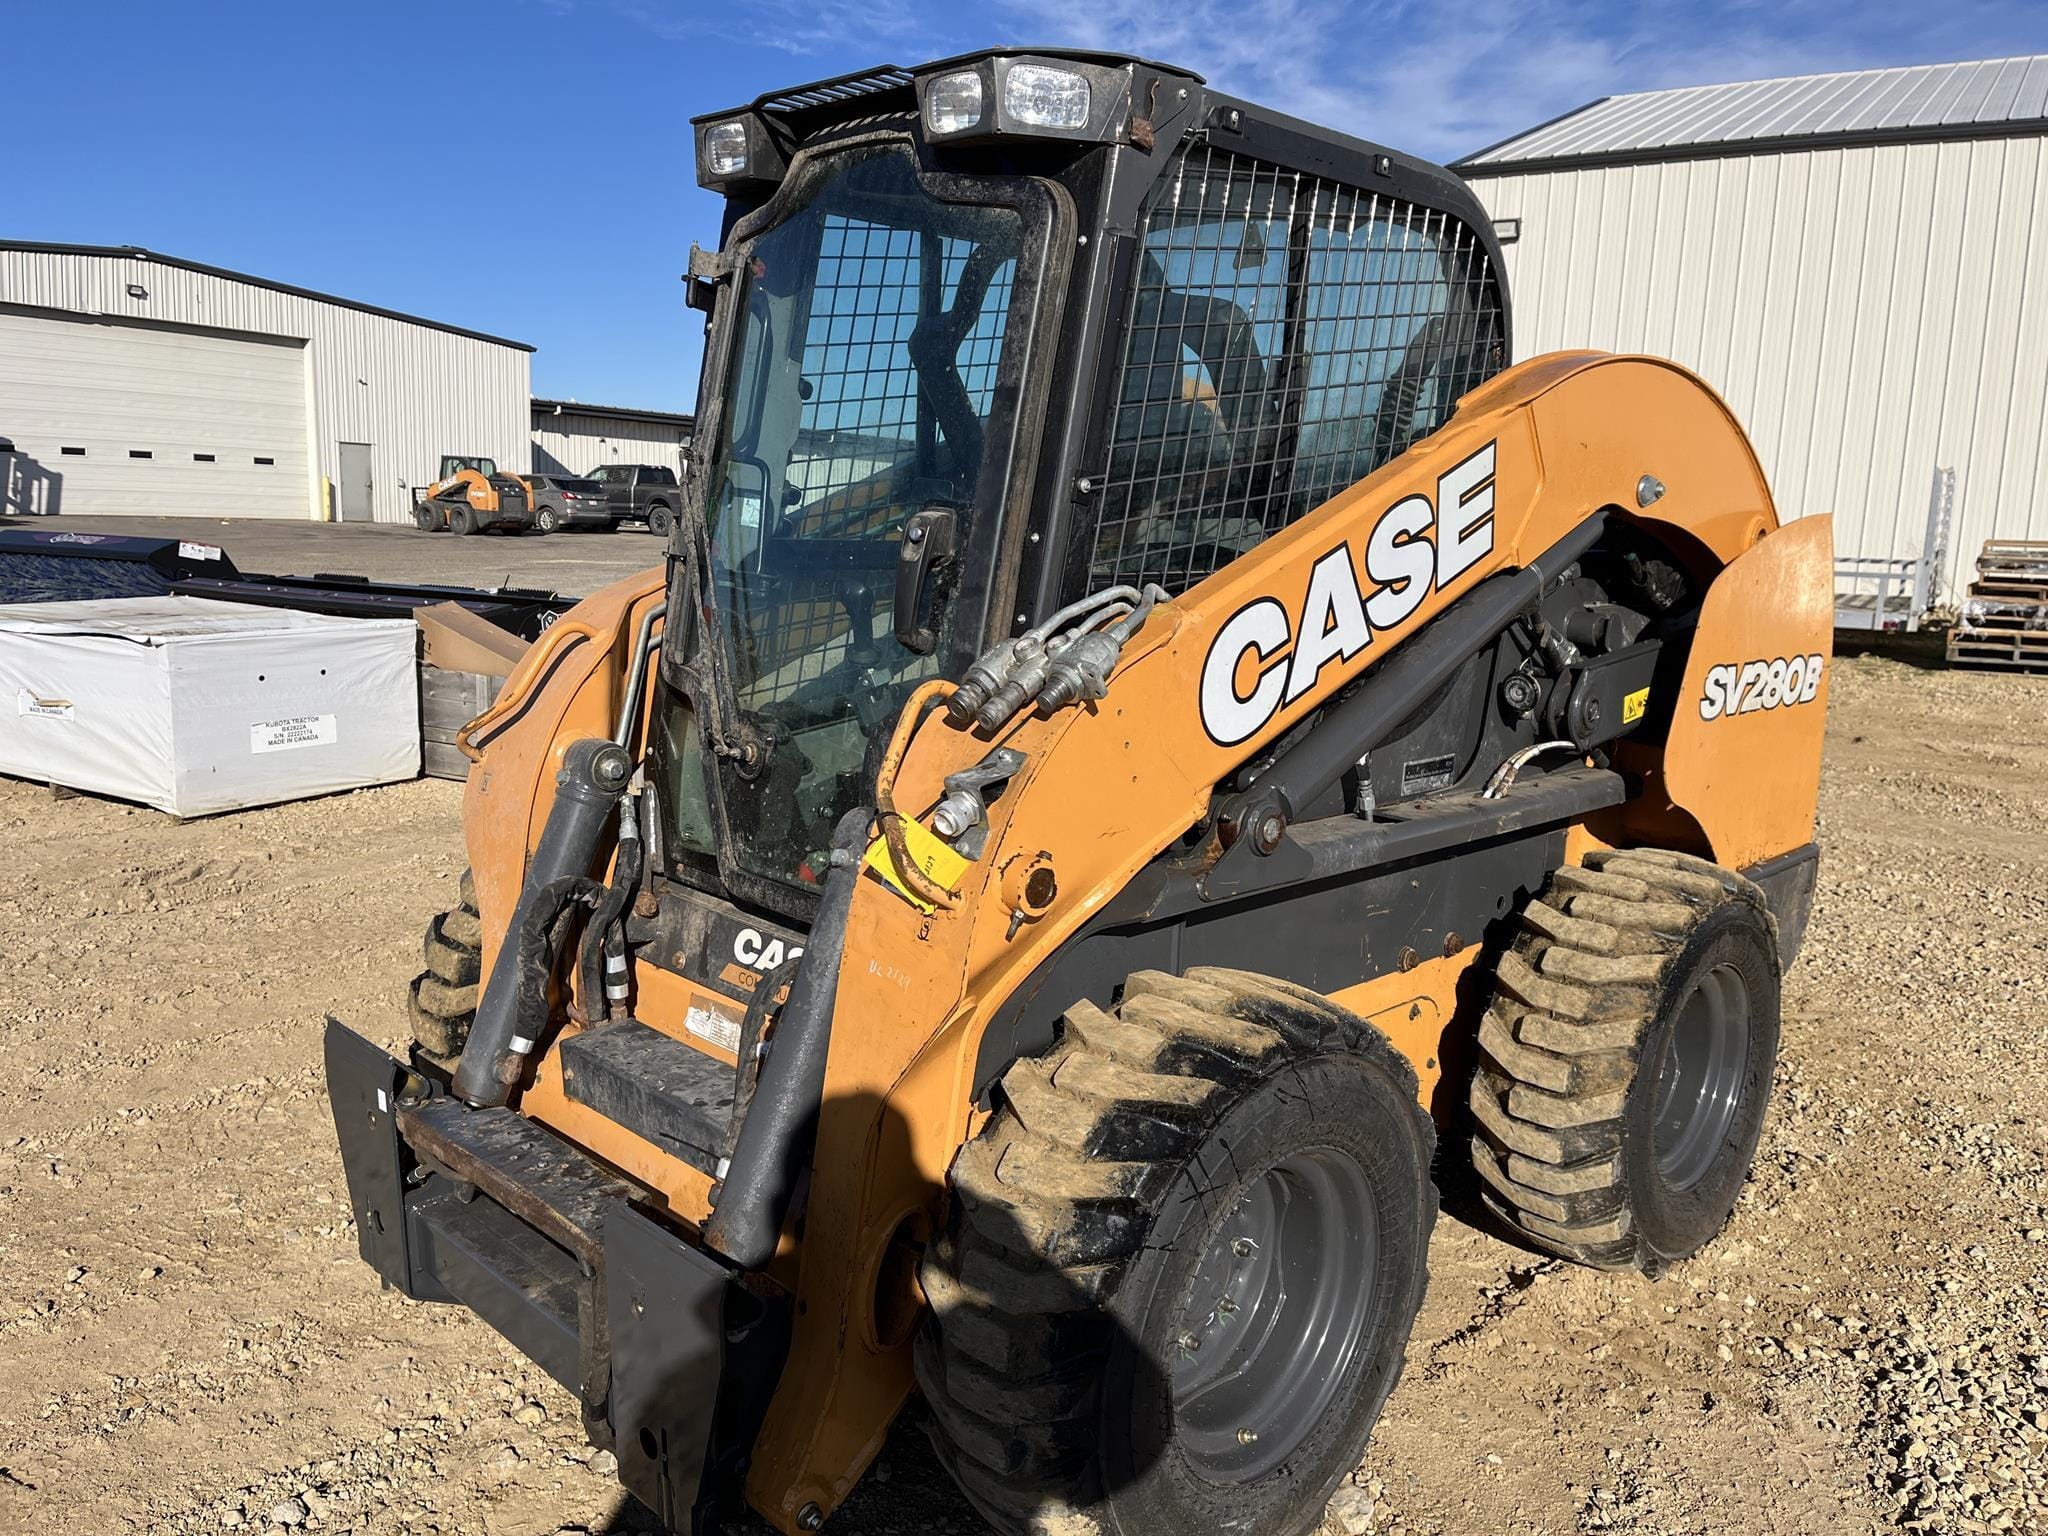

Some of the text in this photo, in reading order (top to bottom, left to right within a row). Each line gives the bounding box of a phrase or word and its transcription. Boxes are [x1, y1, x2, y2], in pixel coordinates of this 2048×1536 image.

[438, 475, 457, 490] CASE
[1199, 437, 1498, 748] CASE
[1700, 653, 1823, 722] SV280B
[265, 716, 319, 728] KUBOTA TRACTOR
[294, 734, 318, 742] CANADA
